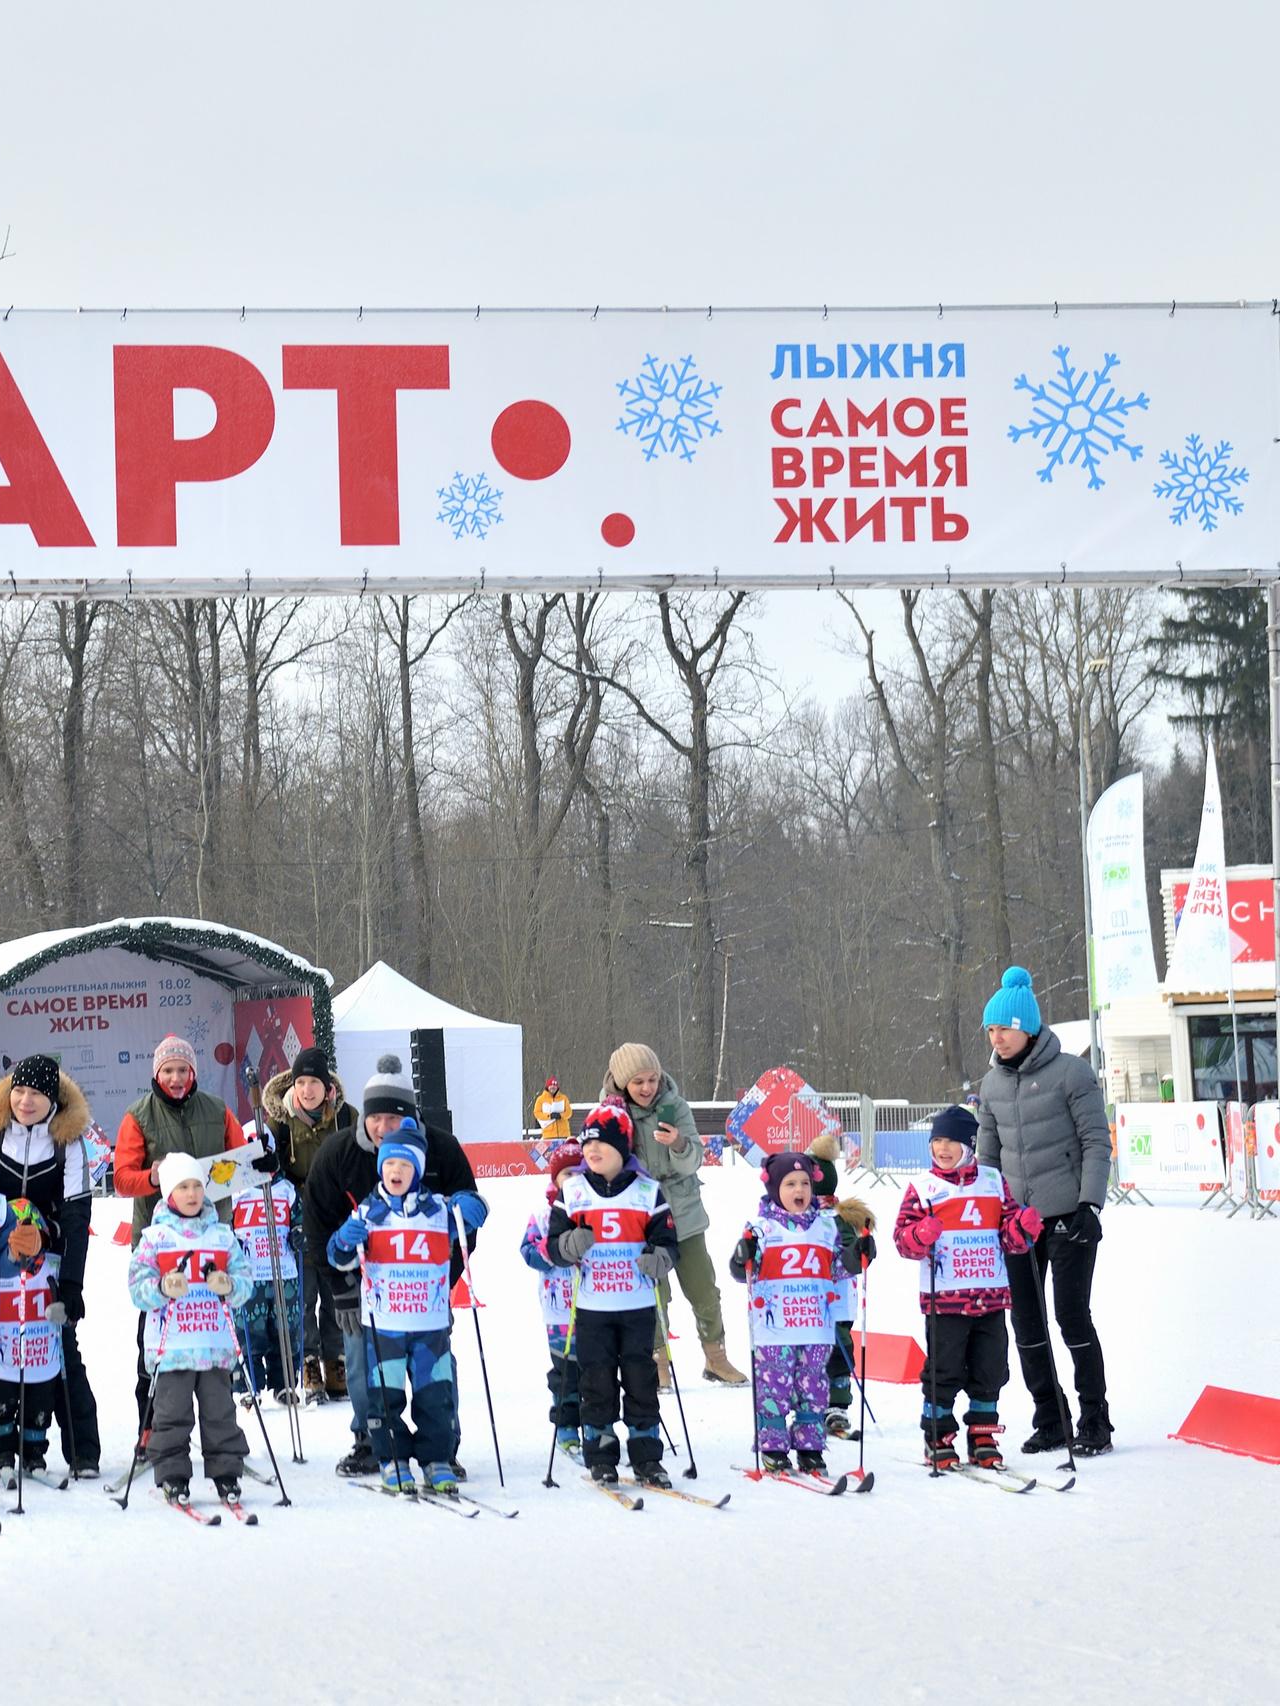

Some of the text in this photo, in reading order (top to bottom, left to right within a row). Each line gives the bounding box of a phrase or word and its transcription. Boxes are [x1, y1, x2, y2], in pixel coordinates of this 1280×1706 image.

[770, 342, 966, 380] ЛЫЖНЯ
[770, 397, 969, 439] САМОЕ
[771, 445, 969, 489] ВРЕМЯ
[773, 496, 970, 544] ЖИТЬ
[6, 978, 191, 997] БЛАГОТВОРИТЕЛЬНАЯ ЛЫЖНЯ 18.02
[7, 993, 192, 1017] САМОЕ ВРЕМЯ 2023
[49, 1015, 110, 1034] ЖИТЬ
[959, 1199, 982, 1227] 4
[601, 1211, 622, 1240] 5
[389, 1232, 430, 1260] 14
[952, 1236, 995, 1245] ЛЫЖНЯ
[591, 1249, 633, 1258] ЛЫЖНЯ
[952, 1247, 995, 1257] САМОЕ
[591, 1260, 633, 1271] САМОЕ
[780, 1247, 821, 1276] 24
[952, 1257, 995, 1268] ВРЕМЯ
[388, 1270, 429, 1278] ЛЫЖНЯ
[592, 1271, 634, 1281] ВРЕМЯ
[953, 1267, 995, 1279] ЖИТЬ
[388, 1281, 429, 1291] САМОЕ
[592, 1281, 634, 1293] ЖИТЬ
[388, 1292, 428, 1302] ВРЕМЯ
[176, 1301, 218, 1311] САМОЕ
[388, 1302, 428, 1313] ЖИТЬ
[176, 1312, 218, 1322] ВРЕМЯ
[784, 1316, 824, 1328] ЖИТЬ
[178, 1322, 219, 1333] ЖИТЬ
